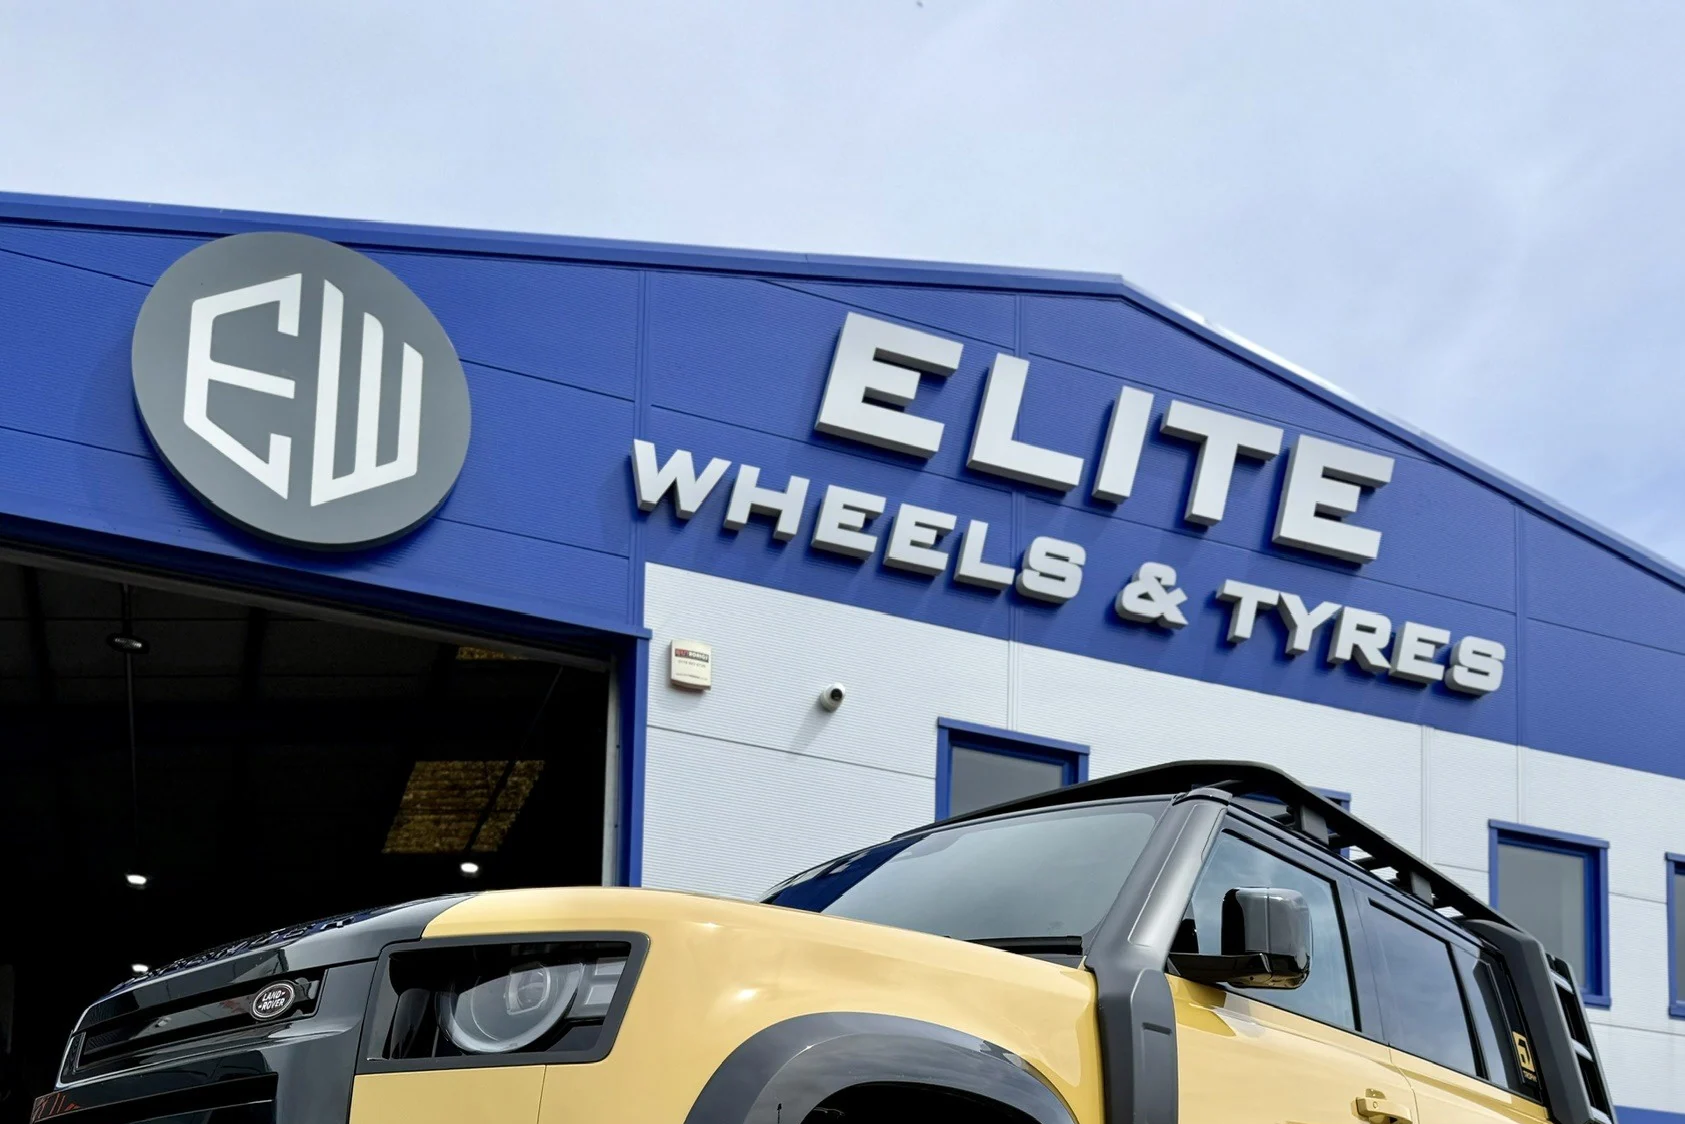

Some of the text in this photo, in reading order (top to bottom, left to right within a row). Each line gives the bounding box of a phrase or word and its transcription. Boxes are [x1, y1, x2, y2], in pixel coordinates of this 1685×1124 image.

[814, 311, 1395, 565] ELITE
[631, 438, 1507, 697] WHEELS & TYRES
[261, 997, 286, 1011] ROVER
[262, 990, 282, 1002] LAND
